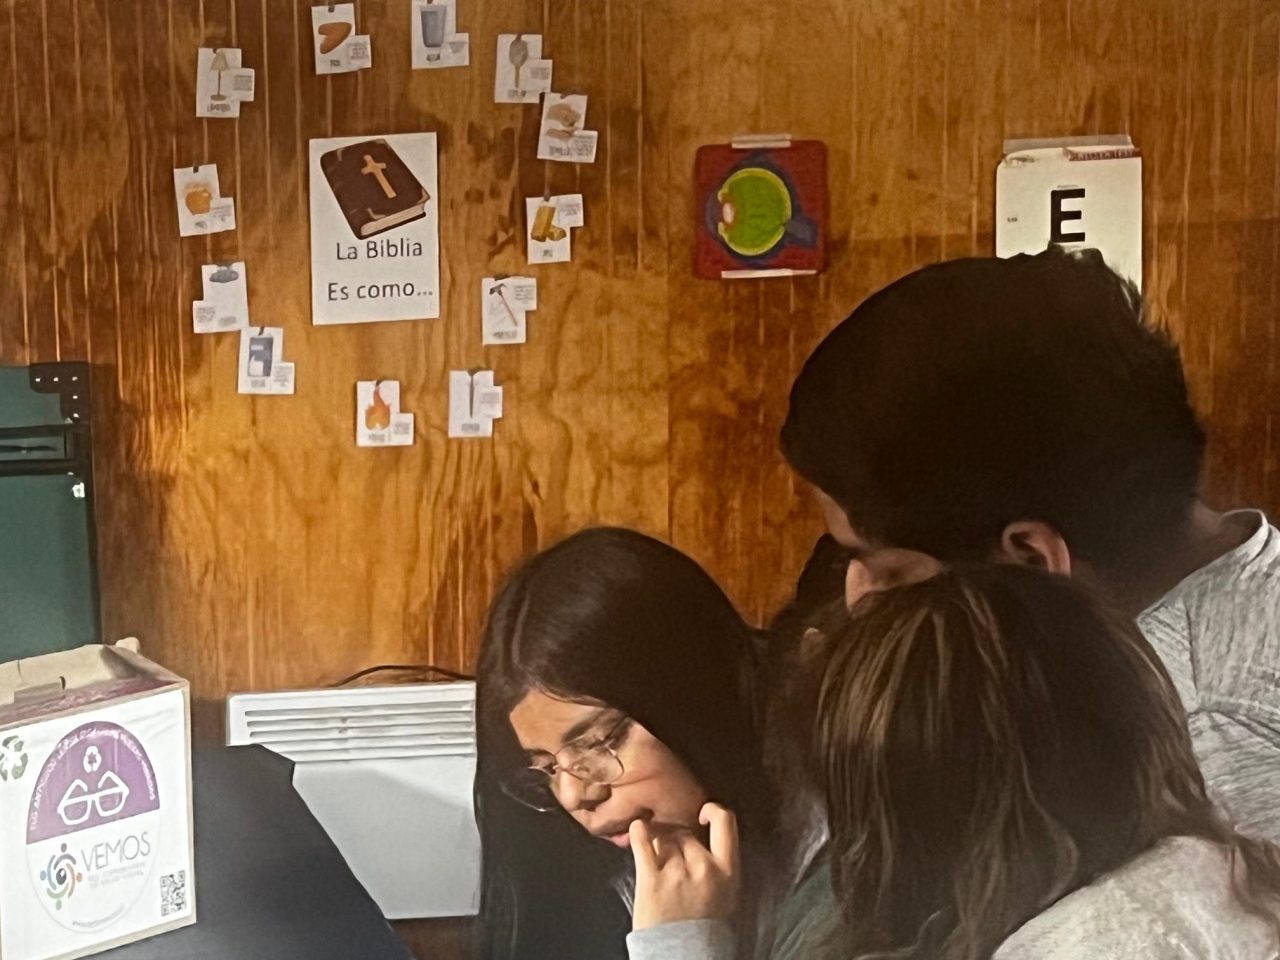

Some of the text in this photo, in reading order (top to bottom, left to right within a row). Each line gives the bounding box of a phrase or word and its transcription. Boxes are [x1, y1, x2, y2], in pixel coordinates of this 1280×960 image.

[1051, 188, 1086, 243] E
[336, 238, 423, 260] La Biblia
[327, 282, 433, 301] Es como...
[80, 831, 151, 872] VEMOS
